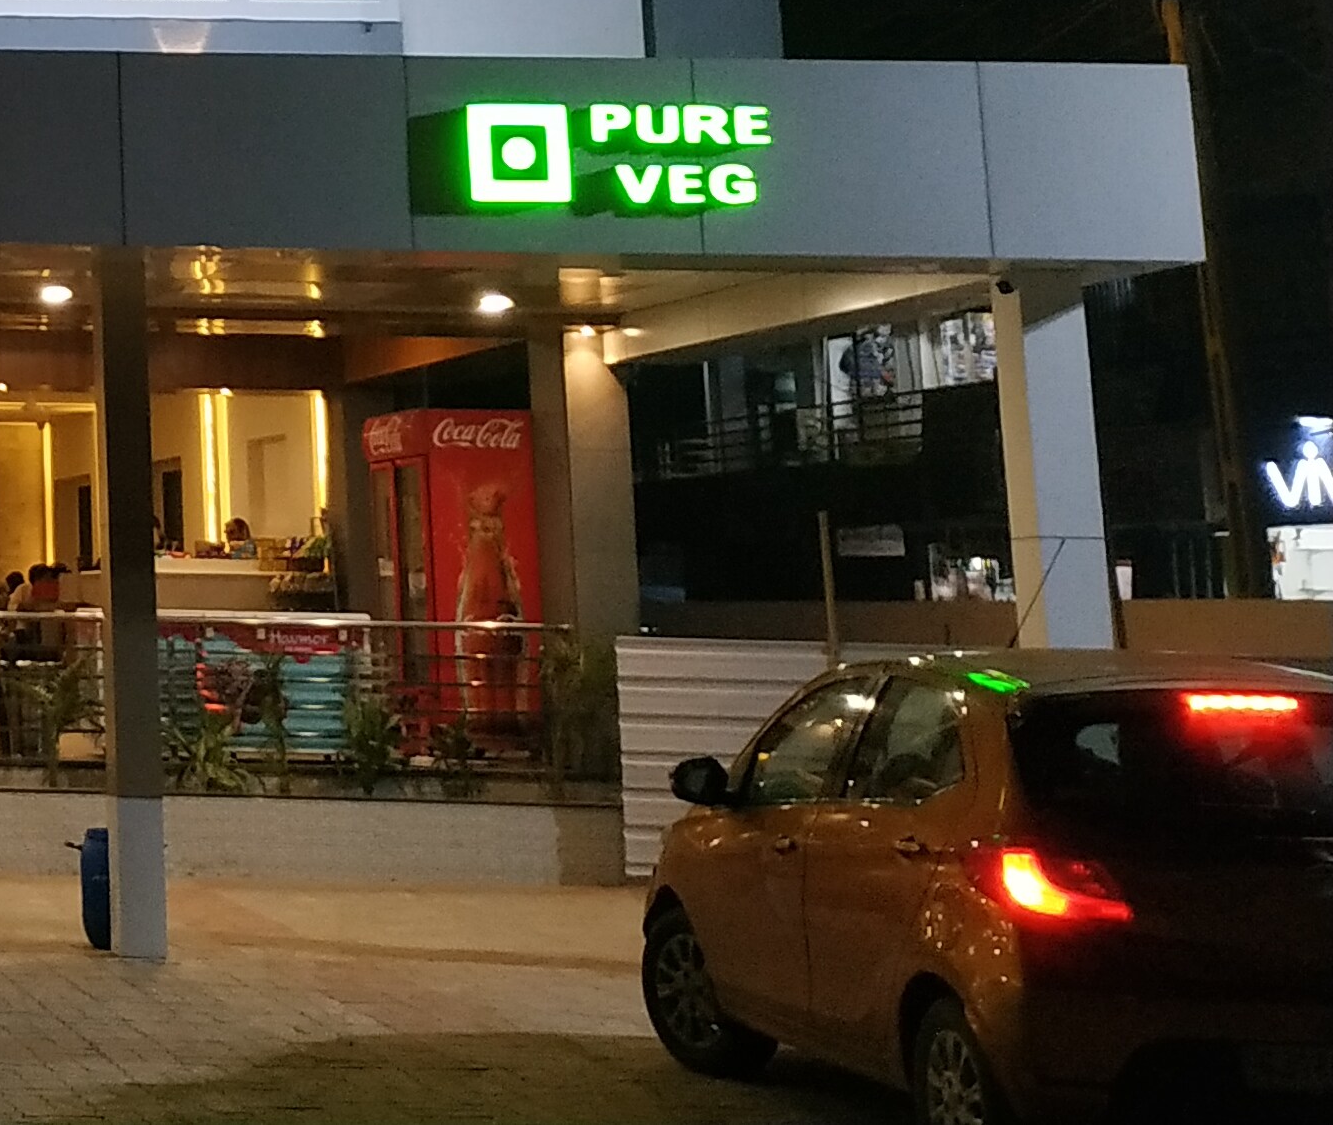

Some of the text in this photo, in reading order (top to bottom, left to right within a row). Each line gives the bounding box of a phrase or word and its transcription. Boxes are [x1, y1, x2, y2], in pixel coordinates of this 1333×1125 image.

[588, 102, 773, 146] PURE
[614, 163, 759, 205] VEG
[433, 417, 524, 449] Coca-Cola
